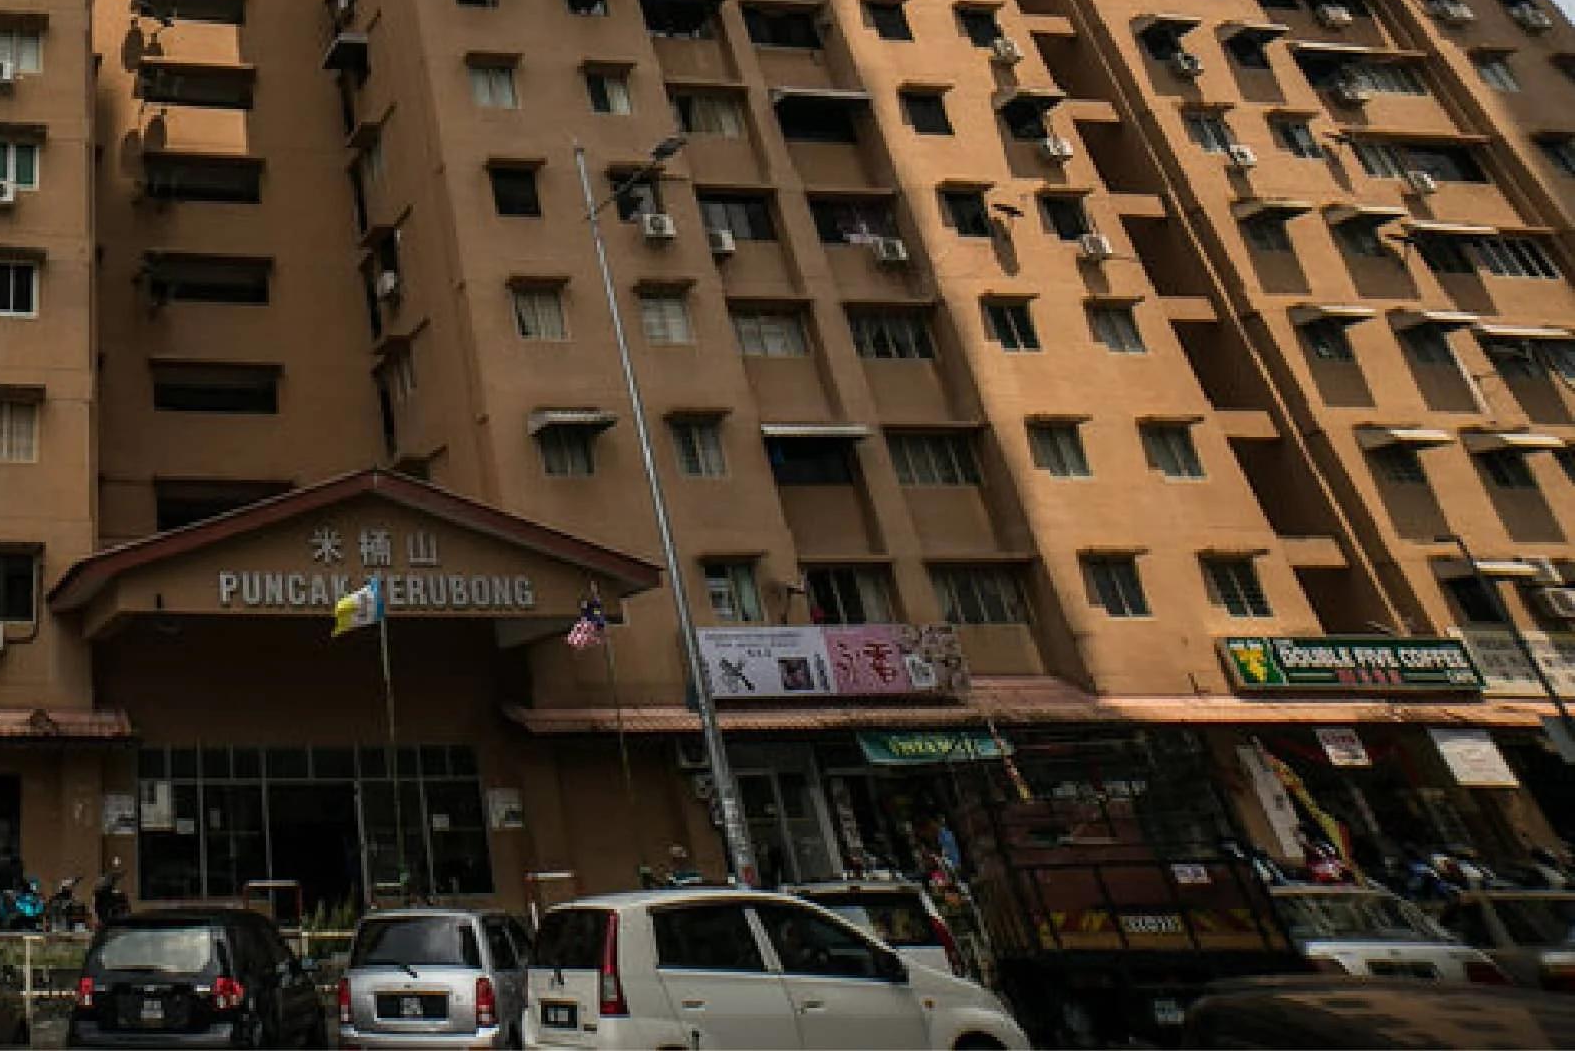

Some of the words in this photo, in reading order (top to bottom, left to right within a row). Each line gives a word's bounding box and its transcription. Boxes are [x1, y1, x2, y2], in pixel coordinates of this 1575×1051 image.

[365, 574, 534, 606] ERUBONG
[1279, 646, 1356, 668] DOUBLE
[1353, 647, 1399, 668] FIVE
[1399, 648, 1469, 669] COFFEE
